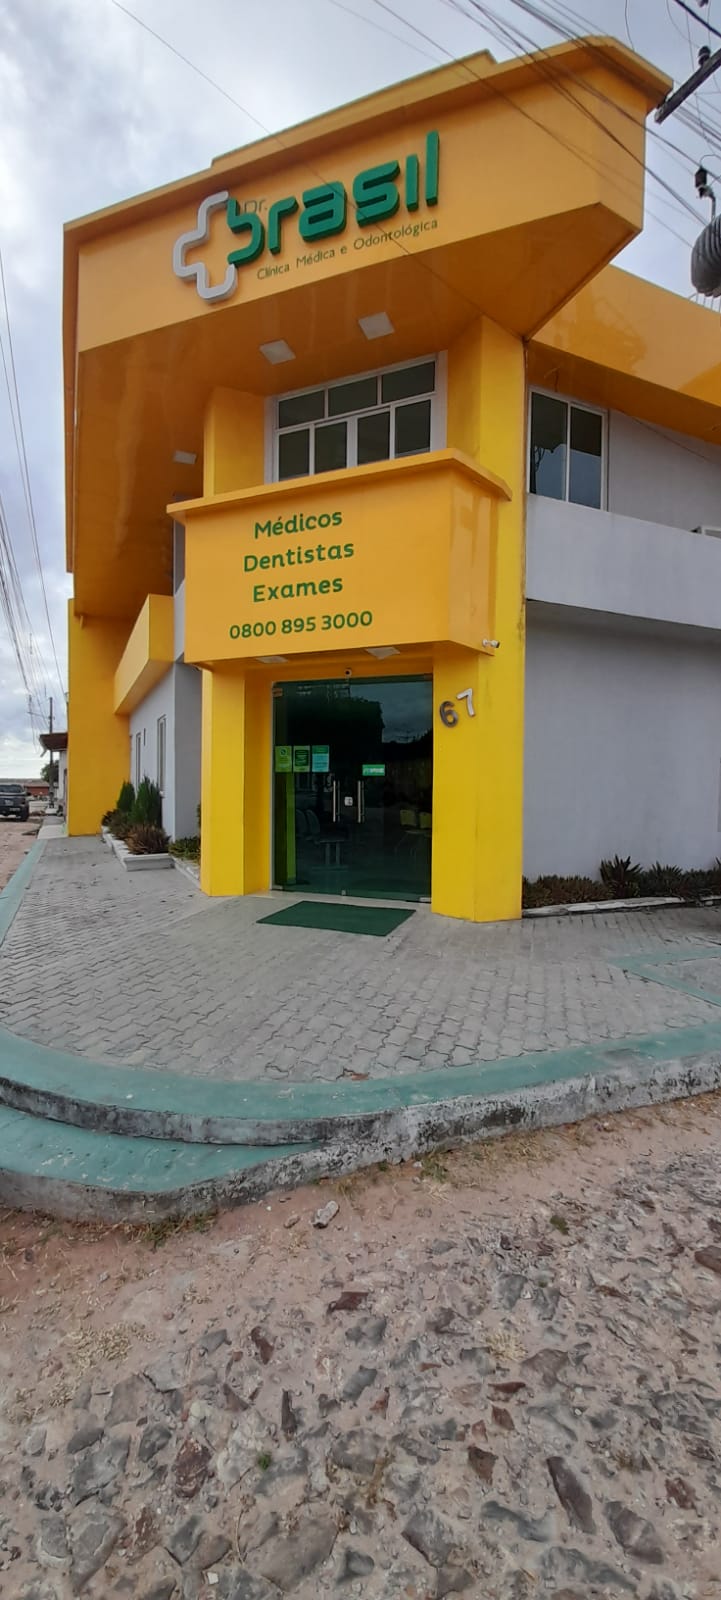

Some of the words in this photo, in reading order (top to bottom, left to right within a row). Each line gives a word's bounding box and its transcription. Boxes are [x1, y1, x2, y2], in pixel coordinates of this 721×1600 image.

[227, 130, 440, 266] brasil
[243, 199, 267, 214] Dr.
[256, 263, 290, 281] Clínica
[296, 249, 335, 268] Médica
[340, 245, 348, 255] e
[353, 218, 438, 251] Odontológica
[254, 511, 343, 539] Médicos
[244, 543, 354, 573] Dentistas
[253, 577, 343, 602] Exames
[229, 621, 276, 639] 0800
[281, 617, 316, 634] 895
[321, 610, 373, 631] 3000
[439, 688, 475, 728] 67
